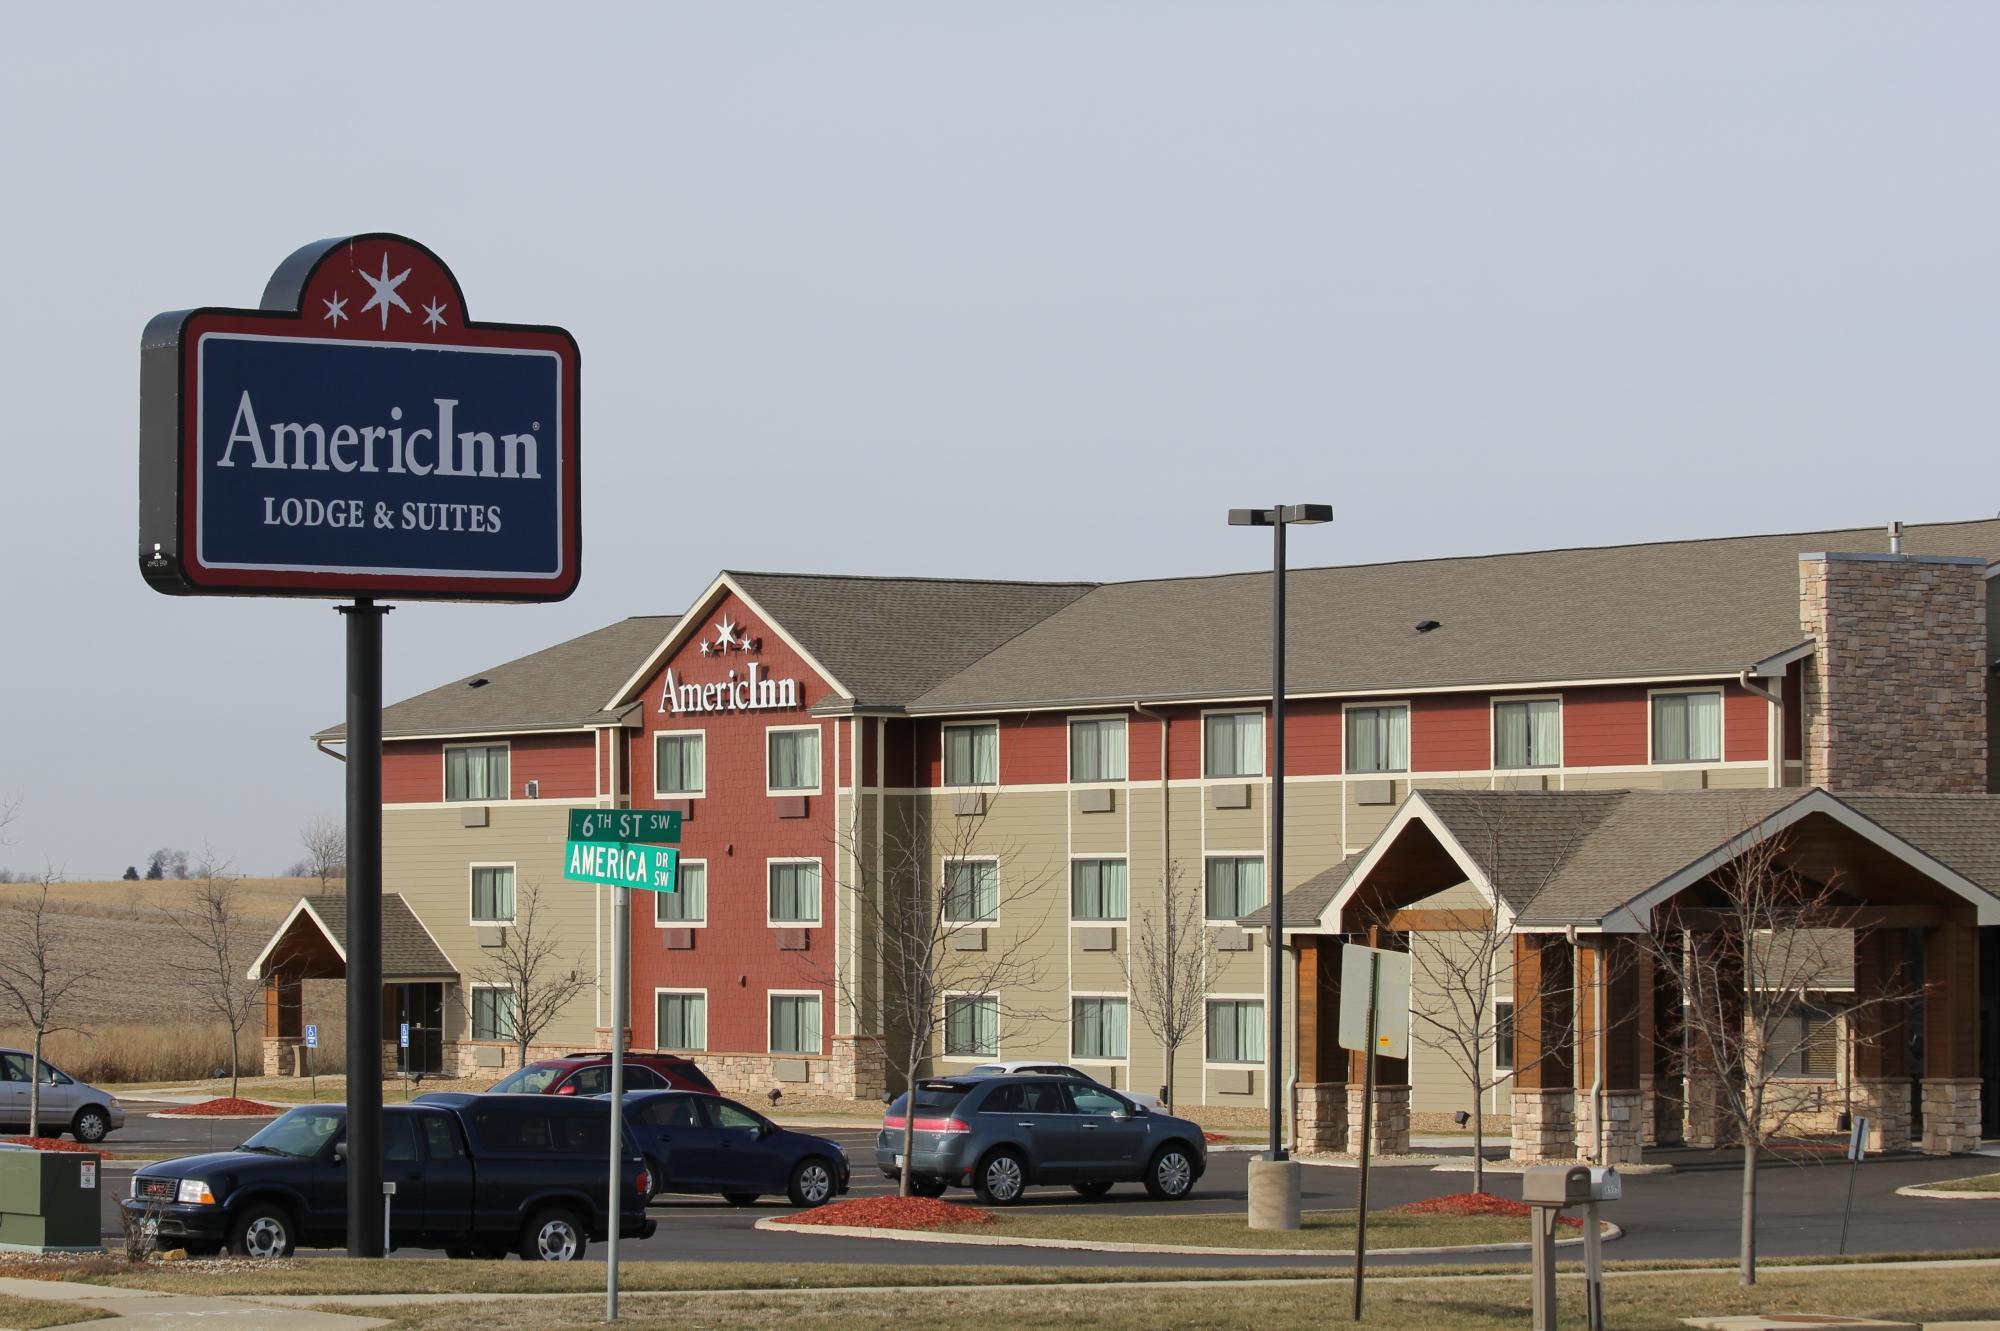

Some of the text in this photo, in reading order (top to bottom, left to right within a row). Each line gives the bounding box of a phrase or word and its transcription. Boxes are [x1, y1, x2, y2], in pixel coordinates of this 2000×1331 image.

[217, 389, 541, 479] AmericInn
[263, 496, 502, 534] LODGE & SUITES
[657, 661, 797, 713] AmericInn
[582, 813, 671, 838] 6TH ST SW
[569, 843, 669, 883] AMERICA DR
[653, 870, 669, 887] SW
